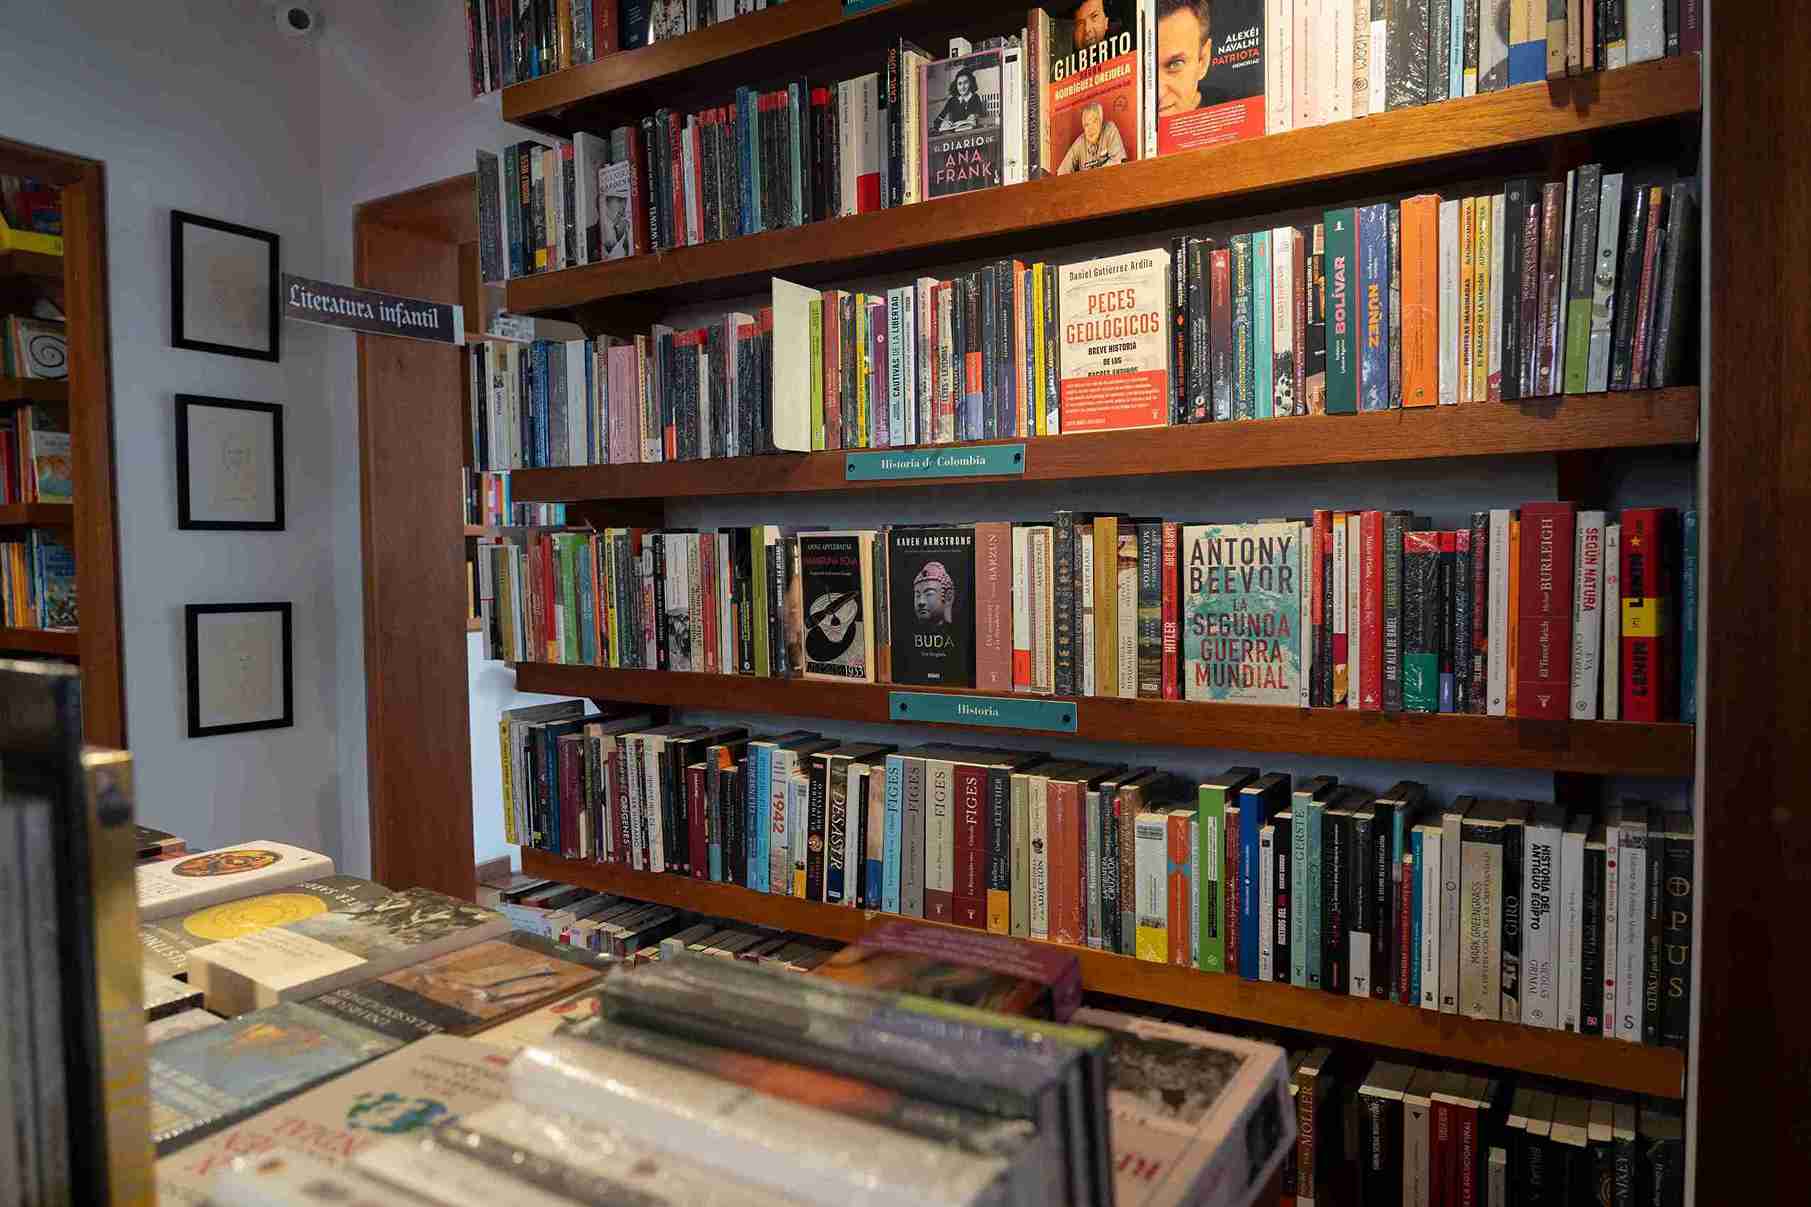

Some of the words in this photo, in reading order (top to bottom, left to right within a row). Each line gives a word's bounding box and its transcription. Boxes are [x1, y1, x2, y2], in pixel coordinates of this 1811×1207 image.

[1217, 37, 1259, 55] NAVALNI
[1225, 27, 1259, 44] ALEXÉI
[1054, 32, 1131, 81] GILBERTO
[1211, 47, 1260, 66] PATRIOTA
[1055, 75, 1094, 100] RODRÍGUEZ
[943, 136, 985, 152] DIARIO
[945, 149, 982, 168] ANA
[936, 161, 992, 185] FRANK
[1069, 269, 1092, 281] Daniel
[1093, 262, 1128, 277] Gutiérrez
[1130, 258, 1153, 270] Ardila
[288, 283, 375, 320] Literatura
[379, 301, 440, 329] infantil
[1087, 288, 1136, 314] PECES
[1331, 256, 1346, 335] BOLÍVAR
[891, 296, 899, 334] LIBERTAD
[1066, 311, 1160, 345] GEOLÓGICOS
[1088, 346, 1108, 356] BREVE
[1108, 342, 1137, 353] HISTORIA
[1103, 358, 1110, 366] DE
[892, 358, 900, 398] CAUTIVAS
[881, 457, 921, 470] Historia
[937, 455, 987, 467] Colombia
[897, 537, 921, 547] KAREN
[923, 536, 972, 547] ARMSTRONG
[1190, 536, 1293, 566] ANTONY
[1539, 518, 1553, 591] BURLEIGH
[1190, 566, 1294, 594] BEEVOR
[1582, 567, 1597, 612] NATURA
[1163, 622, 1177, 653] HITLER
[1192, 611, 1290, 638] SEGUNDA
[914, 633, 955, 648] BUDA
[1200, 638, 1283, 664] GUERRA
[1194, 662, 1289, 690] MUNDIAL
[957, 703, 1000, 717] Historia
[887, 767, 899, 813] FIGES
[907, 767, 920, 814] FIGES
[935, 771, 946, 817] FIGES
[965, 777, 977, 824] FIGES
[994, 778, 1003, 827] FLETCHER
[774, 790, 785, 834] 1942
[1107, 857, 1115, 900] CRUZADA
[1531, 843, 1541, 891] ANTIGUO
[1540, 844, 1551, 892] HISTORIA
[1471, 881, 1481, 938] GREENGRASS
[1530, 892, 1541, 931] EGIPTO
[1540, 895, 1551, 915] DEL
